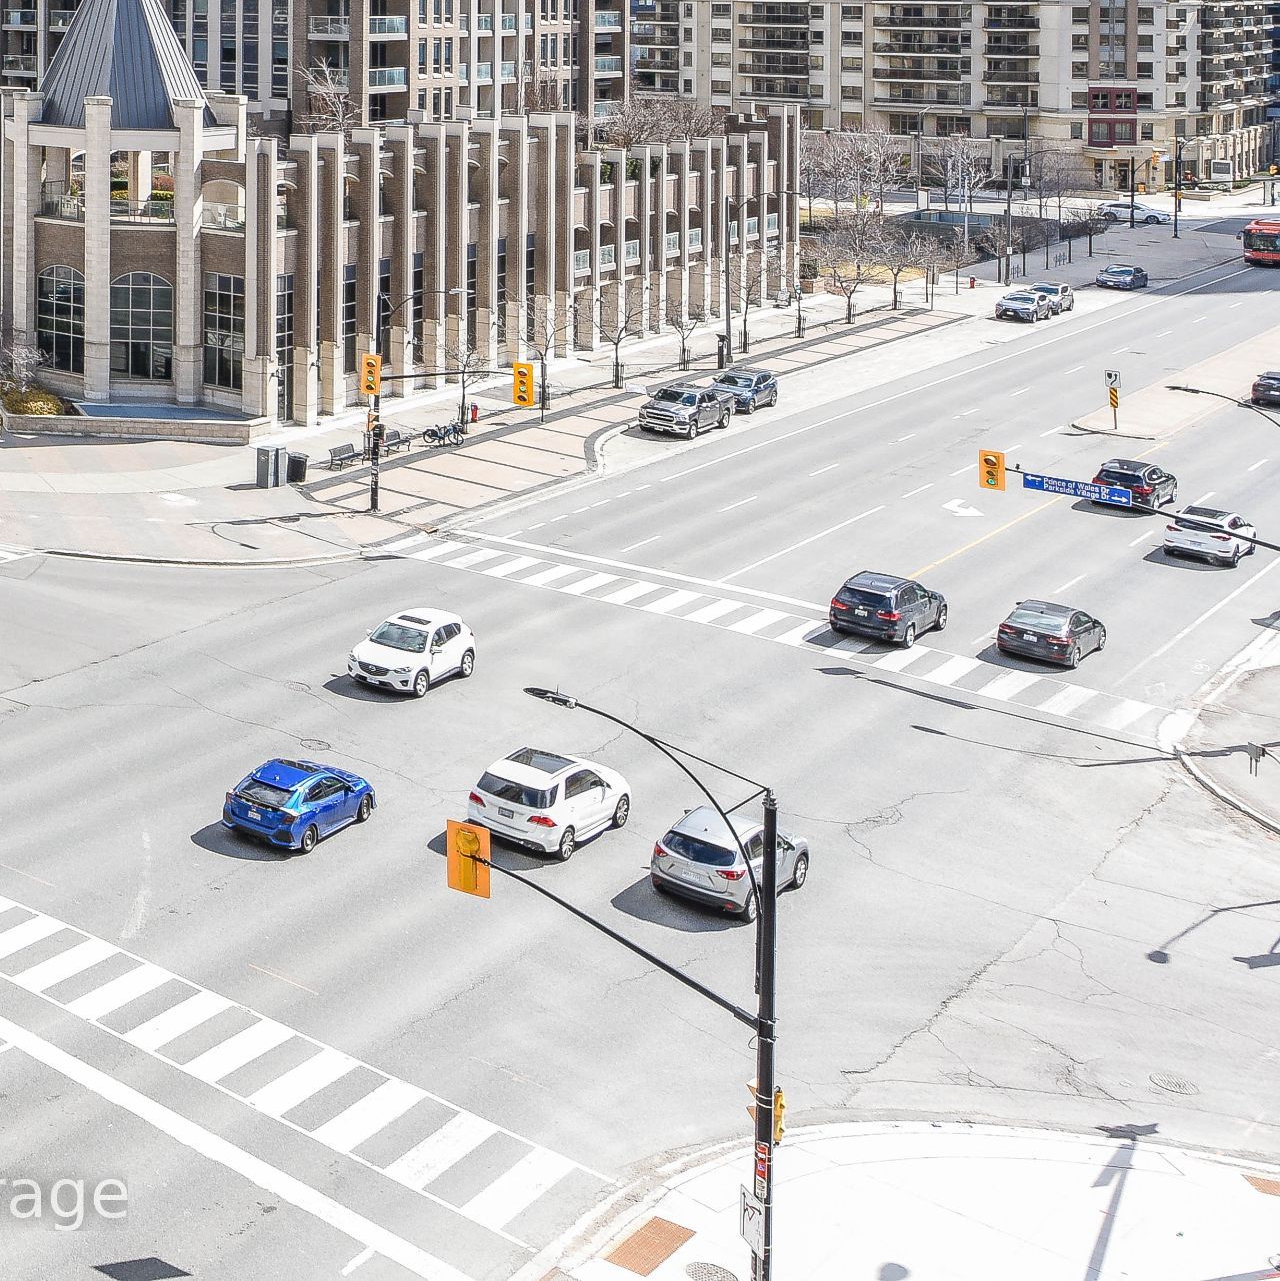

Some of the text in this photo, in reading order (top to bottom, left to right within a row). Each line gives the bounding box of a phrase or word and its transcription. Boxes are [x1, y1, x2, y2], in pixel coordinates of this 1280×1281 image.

[1043, 477, 1110, 494] Prince of Wales Dr
[1043, 482, 1110, 500] Parkside Village Dr
